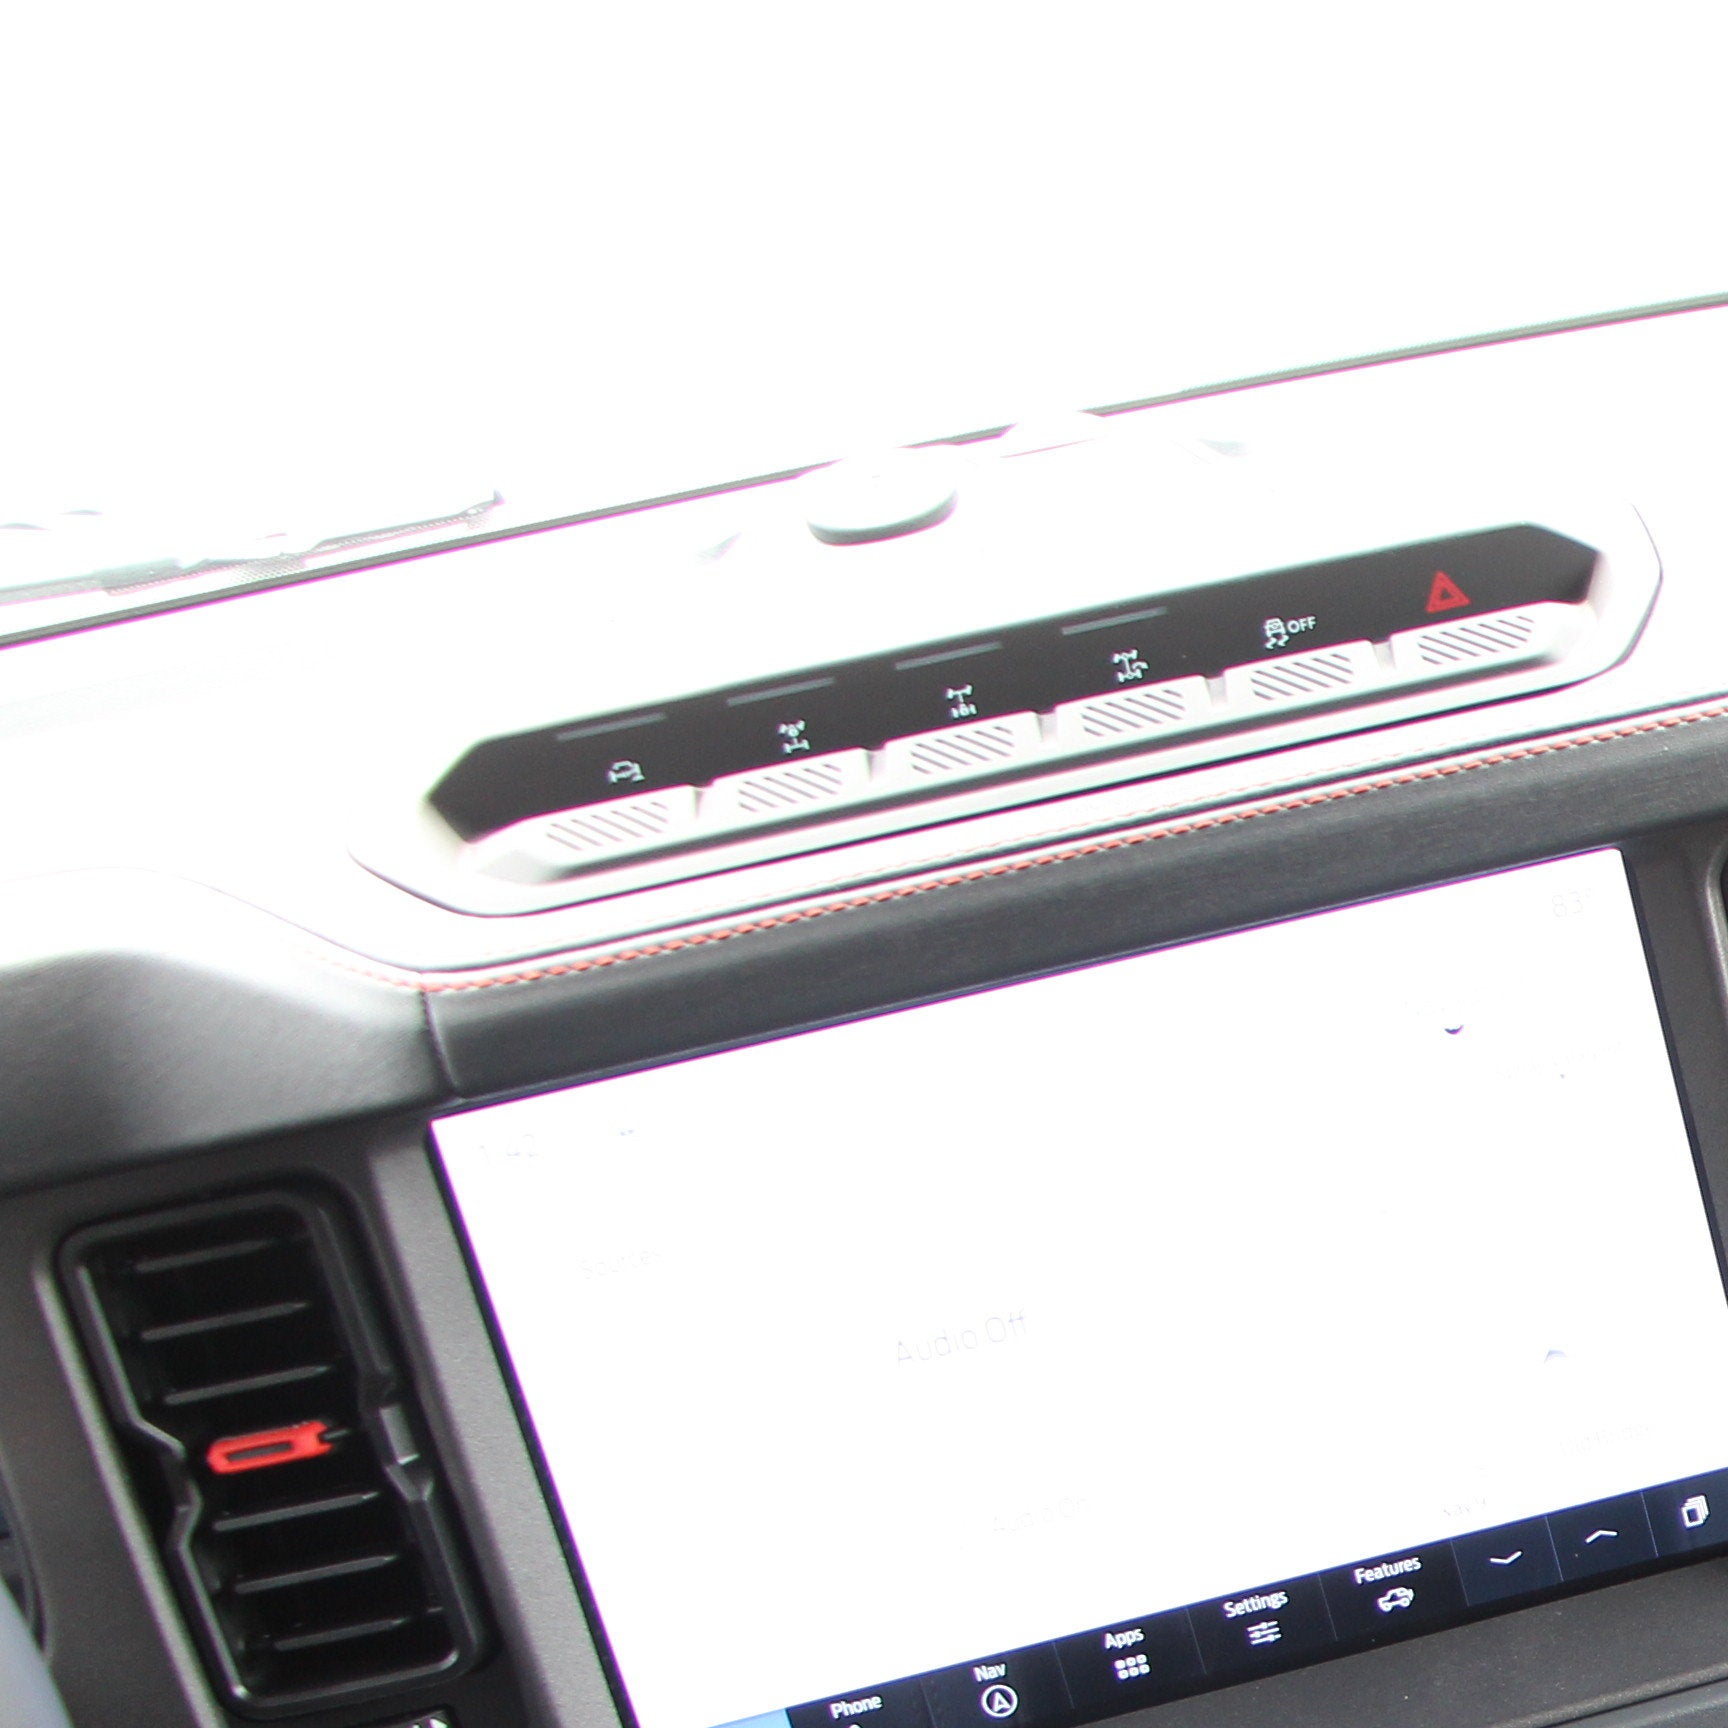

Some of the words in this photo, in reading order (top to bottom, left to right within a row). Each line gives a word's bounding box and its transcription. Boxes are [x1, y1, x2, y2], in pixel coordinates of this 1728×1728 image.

[1287, 615, 1317, 634] OFF
[1354, 1557, 1423, 1586] Features
[1223, 1590, 1289, 1619] Settings
[1104, 1627, 1146, 1651] Apps
[973, 1663, 1007, 1683] Nav
[830, 1695, 884, 1721] Phone
